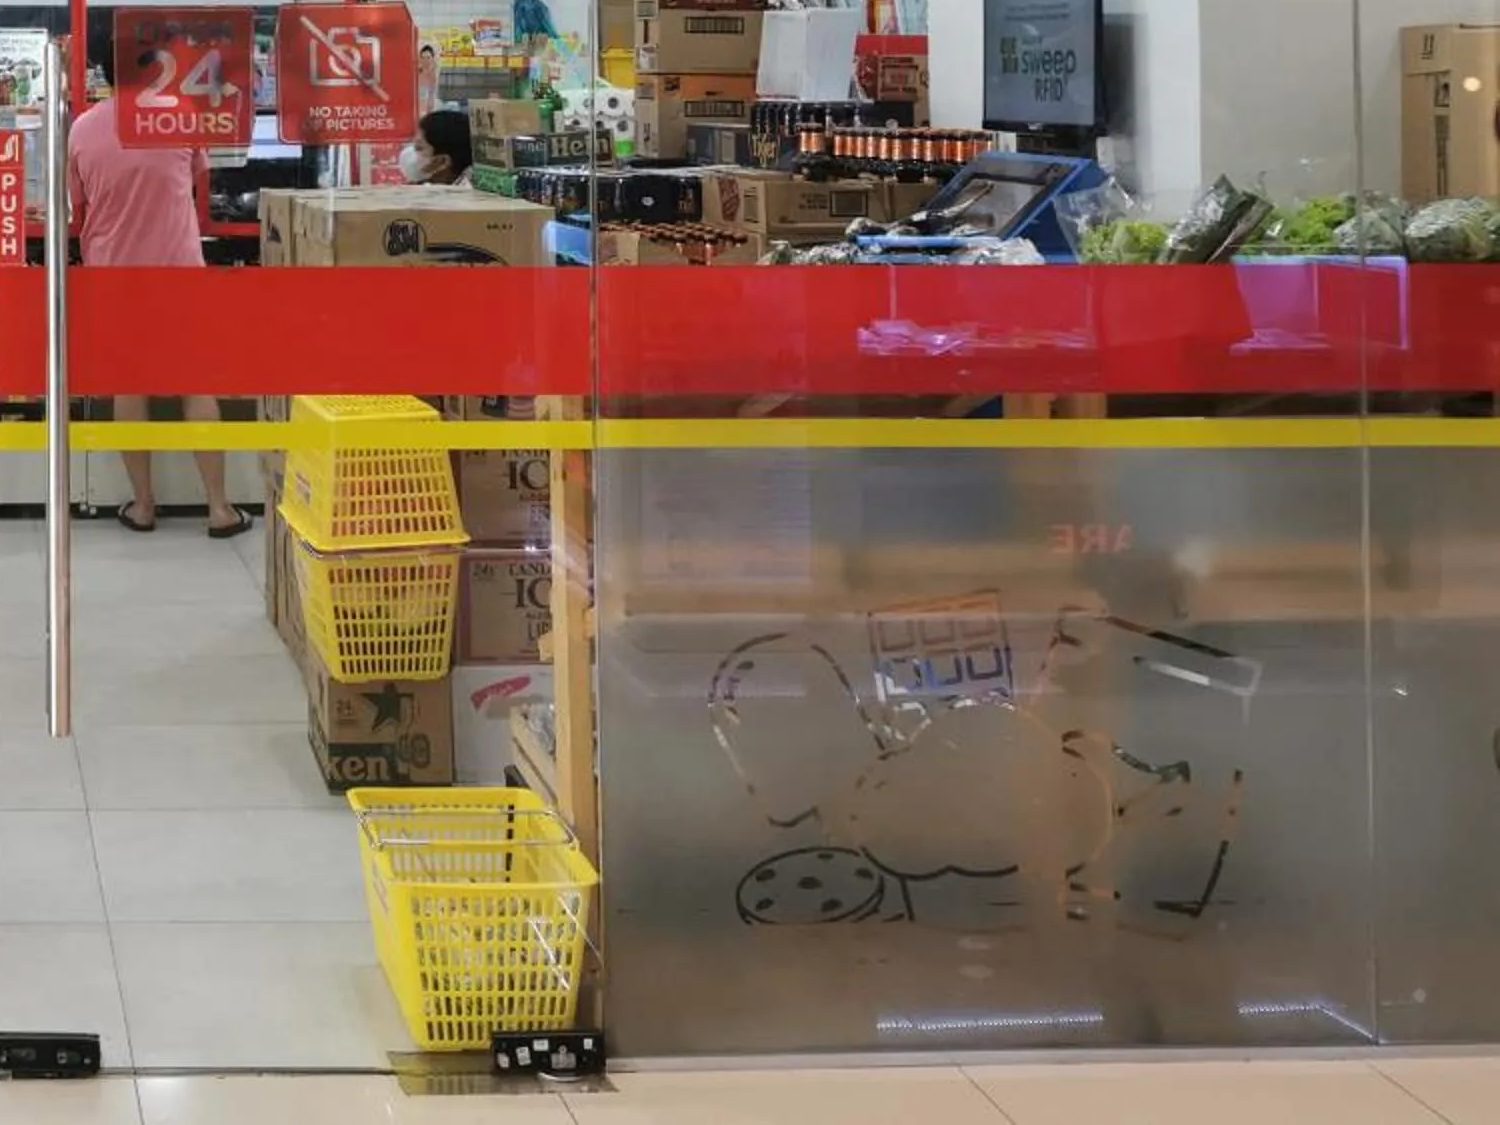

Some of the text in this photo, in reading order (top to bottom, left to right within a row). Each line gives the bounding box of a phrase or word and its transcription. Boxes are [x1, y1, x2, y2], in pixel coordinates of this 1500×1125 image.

[135, 49, 222, 108] 24
[1020, 49, 1077, 86] sweep
[309, 104, 388, 118] NO TAKING
[135, 112, 234, 135] HOURS
[325, 117, 396, 131] PICTURES
[552, 135, 611, 158] Hen
[1, 174, 18, 256] PUSH
